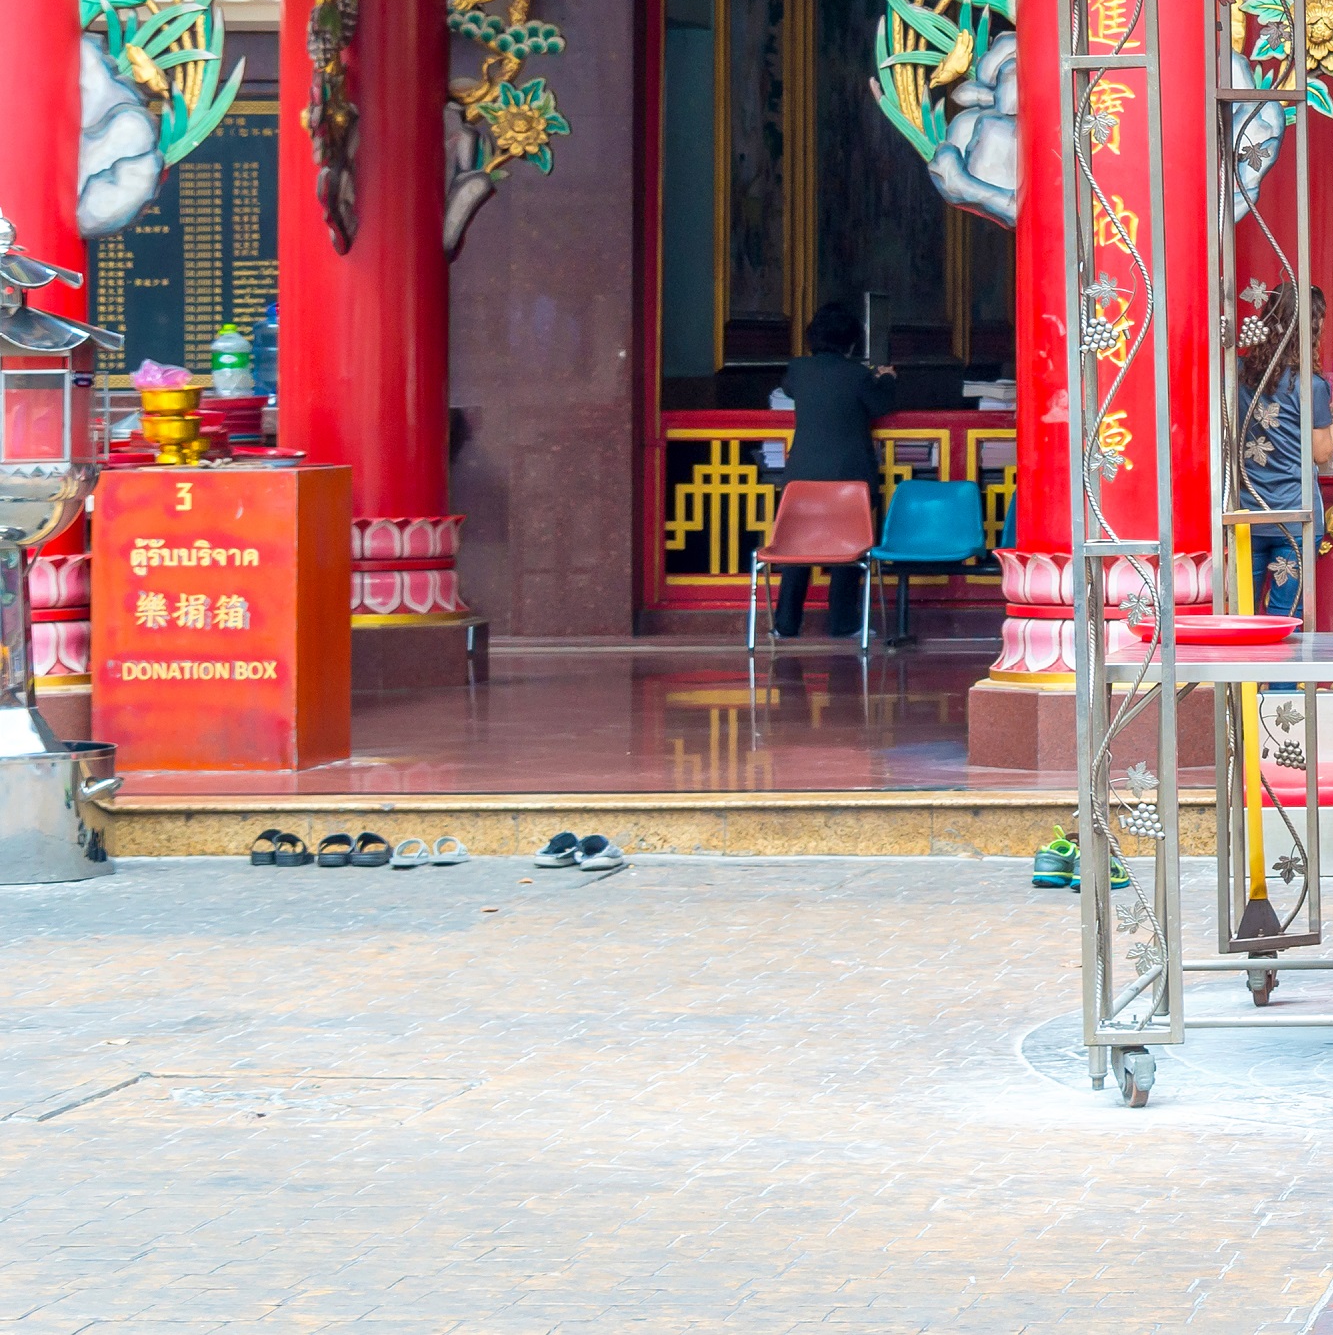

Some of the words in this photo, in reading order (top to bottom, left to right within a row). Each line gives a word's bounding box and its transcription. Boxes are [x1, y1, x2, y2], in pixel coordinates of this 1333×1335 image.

[175, 482, 194, 511] 3
[130, 538, 259, 576] ตู้รับบริจาค
[134, 591, 247, 630] 樂捐箱
[121, 662, 231, 680] DONATION
[235, 661, 278, 679] BOX
